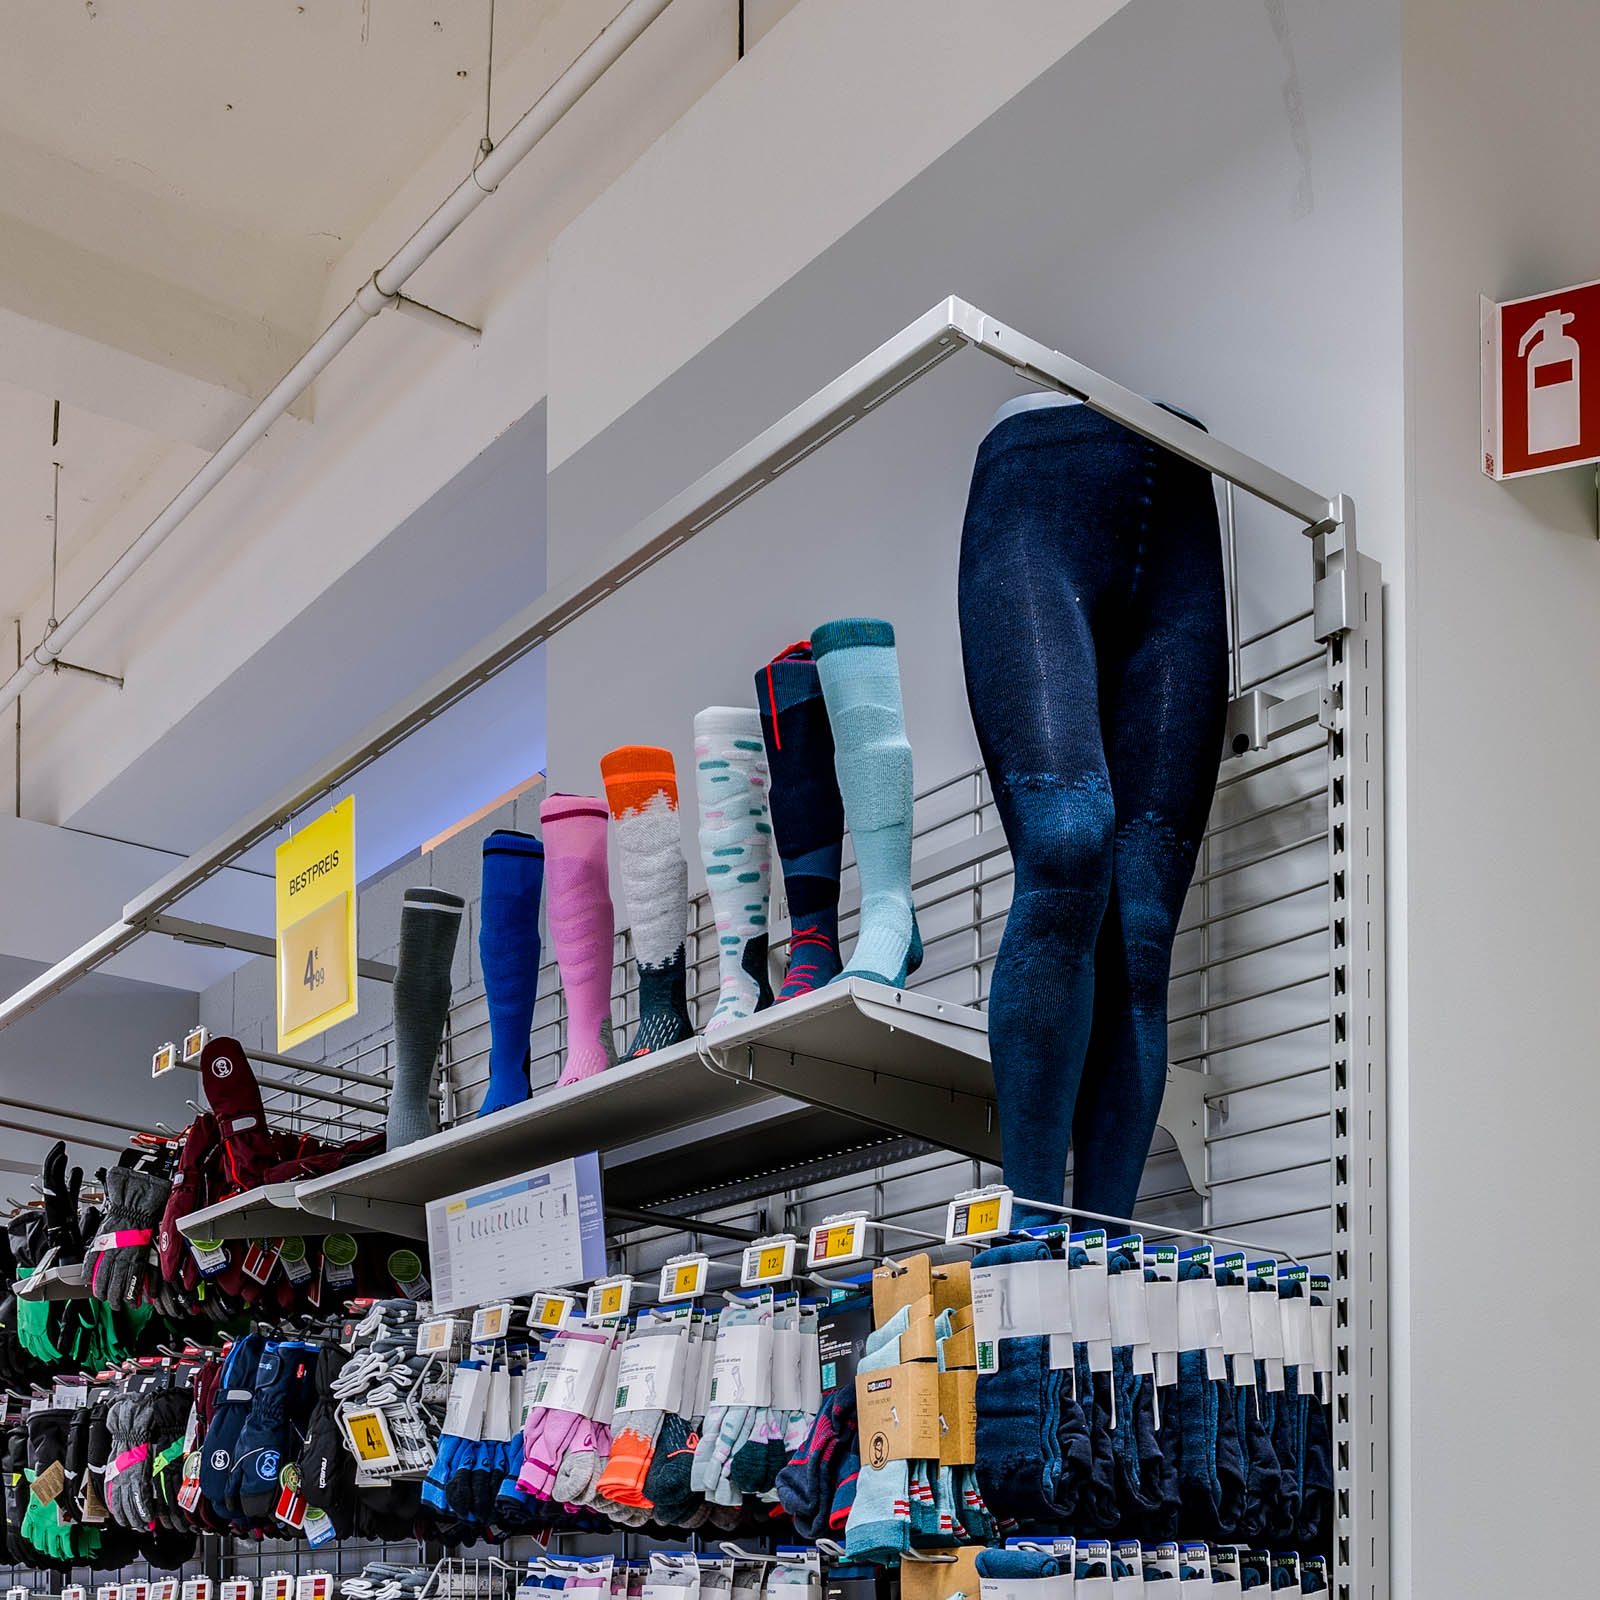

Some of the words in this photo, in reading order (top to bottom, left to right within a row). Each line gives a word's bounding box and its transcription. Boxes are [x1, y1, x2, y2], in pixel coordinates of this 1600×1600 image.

[289, 850, 339, 897] BESTPREIS
[1085, 1237, 1102, 1247] 35/38
[1157, 1251, 1174, 1261] 35/38
[1192, 1252, 1209, 1263] 35/38
[1225, 1258, 1242, 1269] 35/38
[1256, 1266, 1273, 1276] 35/38
[1288, 1271, 1306, 1281] 35/38
[1310, 1279, 1328, 1289] 35/38
[319, 1457, 328, 1489] reusch
[1053, 1542, 1071, 1552] 31/34
[1089, 1546, 1107, 1555] 31/34
[1120, 1546, 1137, 1555] 31/34
[1157, 1547, 1174, 1556] 31/34
[1187, 1548, 1204, 1558] 31/34
[1218, 1552, 1235, 1561] 35/38
[1278, 1557, 1294, 1566] 35/38
[1304, 1561, 1321, 1569] 35/38
